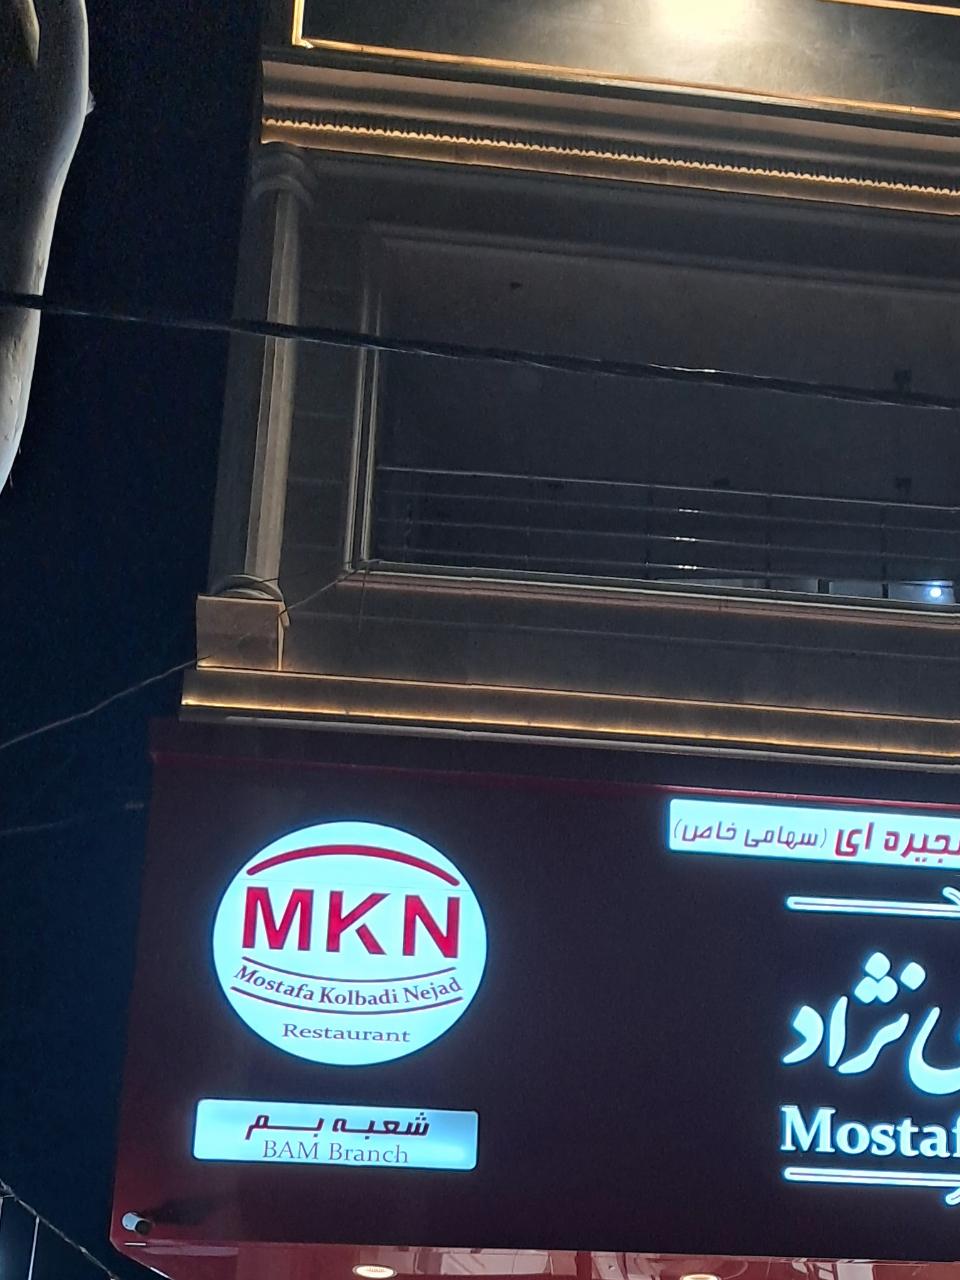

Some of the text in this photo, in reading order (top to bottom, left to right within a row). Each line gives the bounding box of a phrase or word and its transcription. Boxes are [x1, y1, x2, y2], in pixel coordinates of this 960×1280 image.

[834, 821, 875, 858] ای
[241, 886, 461, 959] MKN
[232, 964, 464, 1006] Mostafa Kolbadi Nejad
[781, 950, 926, 1074] نژاد
[282, 1023, 411, 1043] Restaurant
[332, 1111, 431, 1140] شعبه
[262, 1140, 409, 1164] BAM Branch
